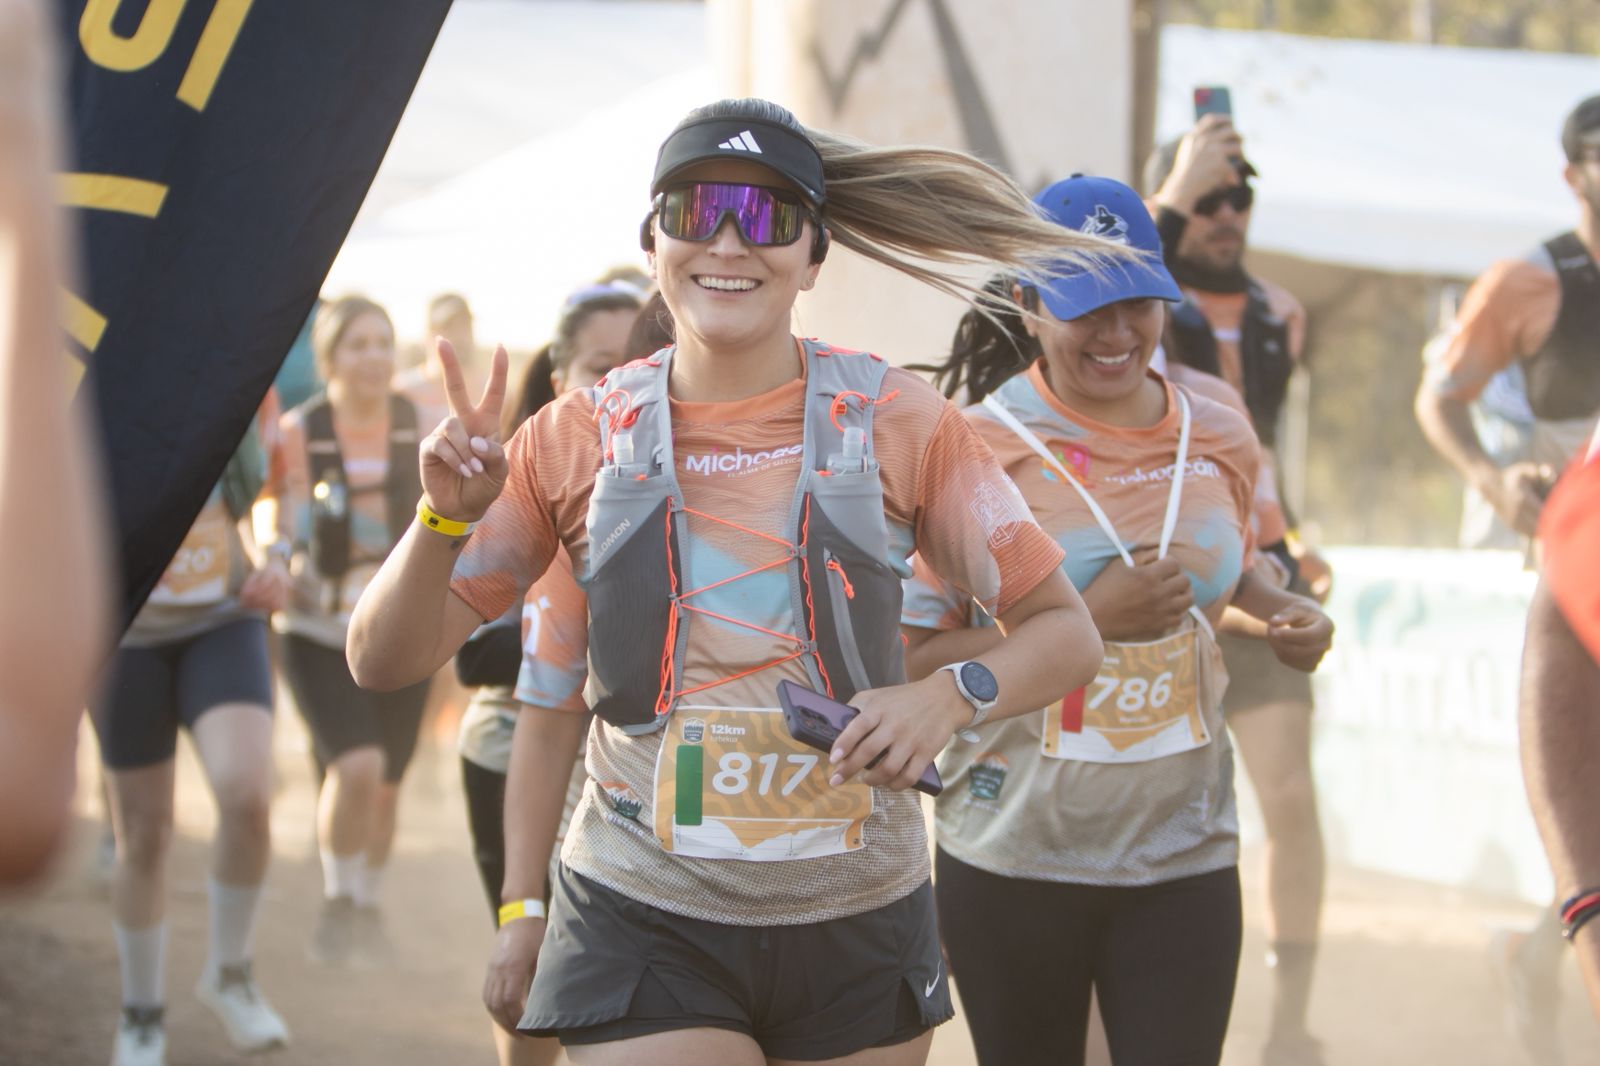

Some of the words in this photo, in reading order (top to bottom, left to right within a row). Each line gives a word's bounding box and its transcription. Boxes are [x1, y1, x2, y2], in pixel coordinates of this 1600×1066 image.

[1087, 671, 1173, 712] 786
[709, 724, 746, 735] 12km
[712, 752, 819, 797] 817
